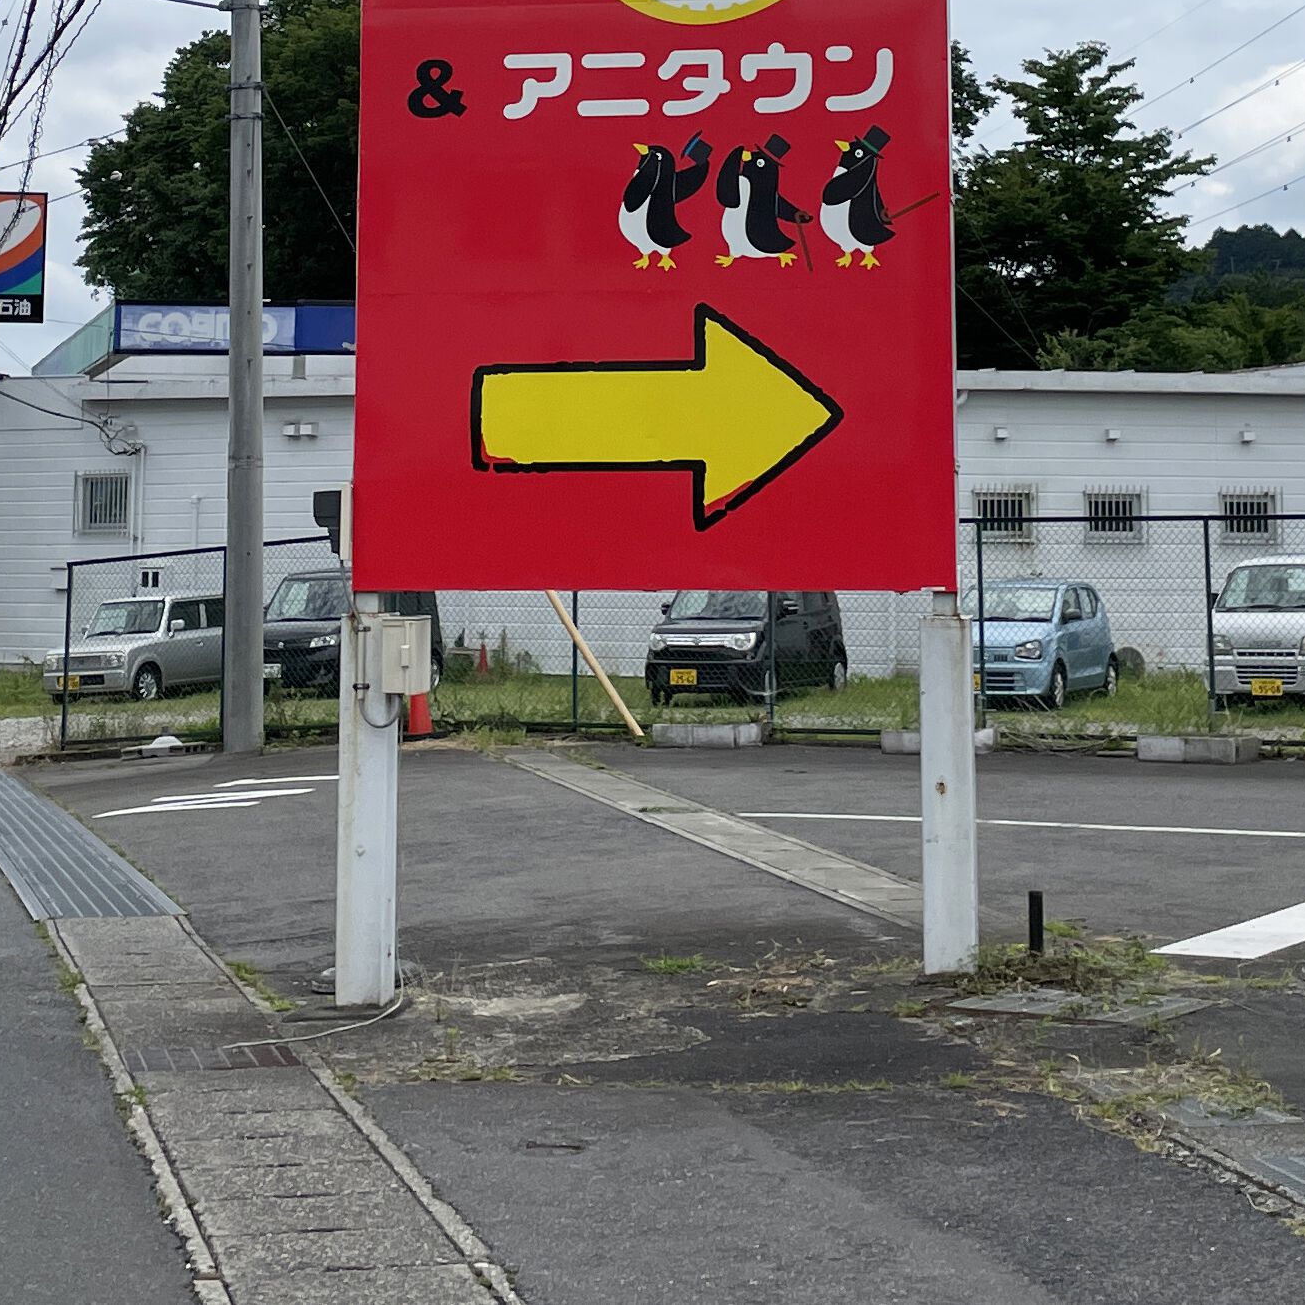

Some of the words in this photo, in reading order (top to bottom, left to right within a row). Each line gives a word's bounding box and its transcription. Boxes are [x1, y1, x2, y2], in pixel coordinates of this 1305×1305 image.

[408, 59, 467, 119] &
[502, 42, 894, 120] アニタウン
